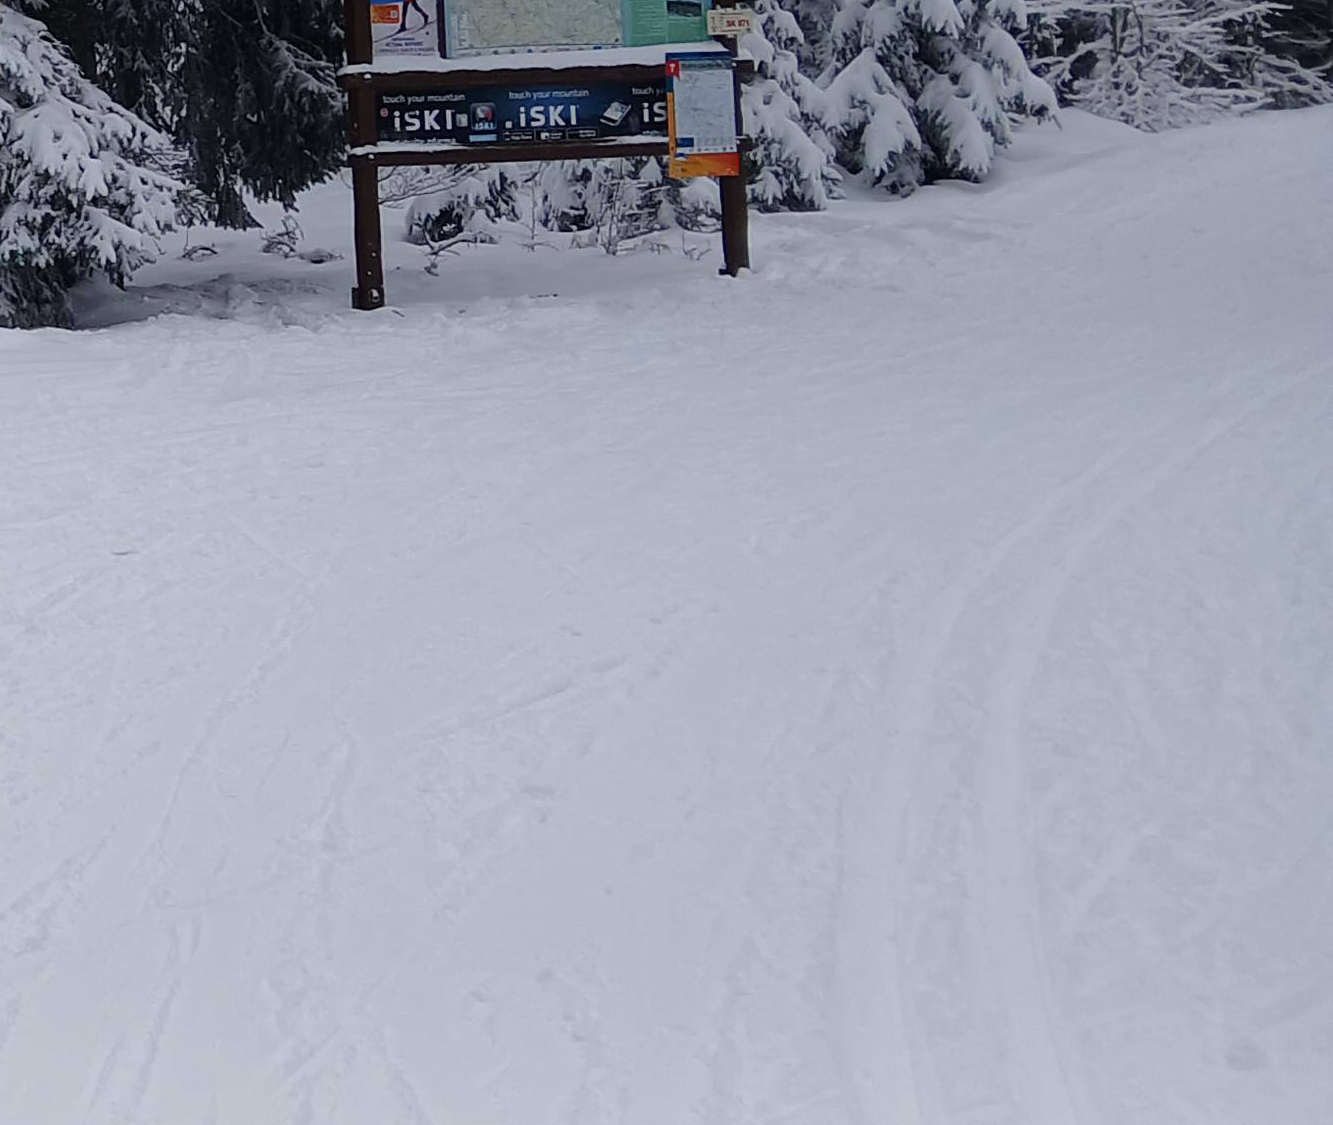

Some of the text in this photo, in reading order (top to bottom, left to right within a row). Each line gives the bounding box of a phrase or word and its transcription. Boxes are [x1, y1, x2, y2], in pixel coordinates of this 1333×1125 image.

[383, 93, 466, 105] touch your mountain
[508, 89, 590, 101] touch your mountain
[393, 109, 454, 132] iSKI
[519, 104, 577, 127] iSKI
[642, 101, 667, 123] iS
